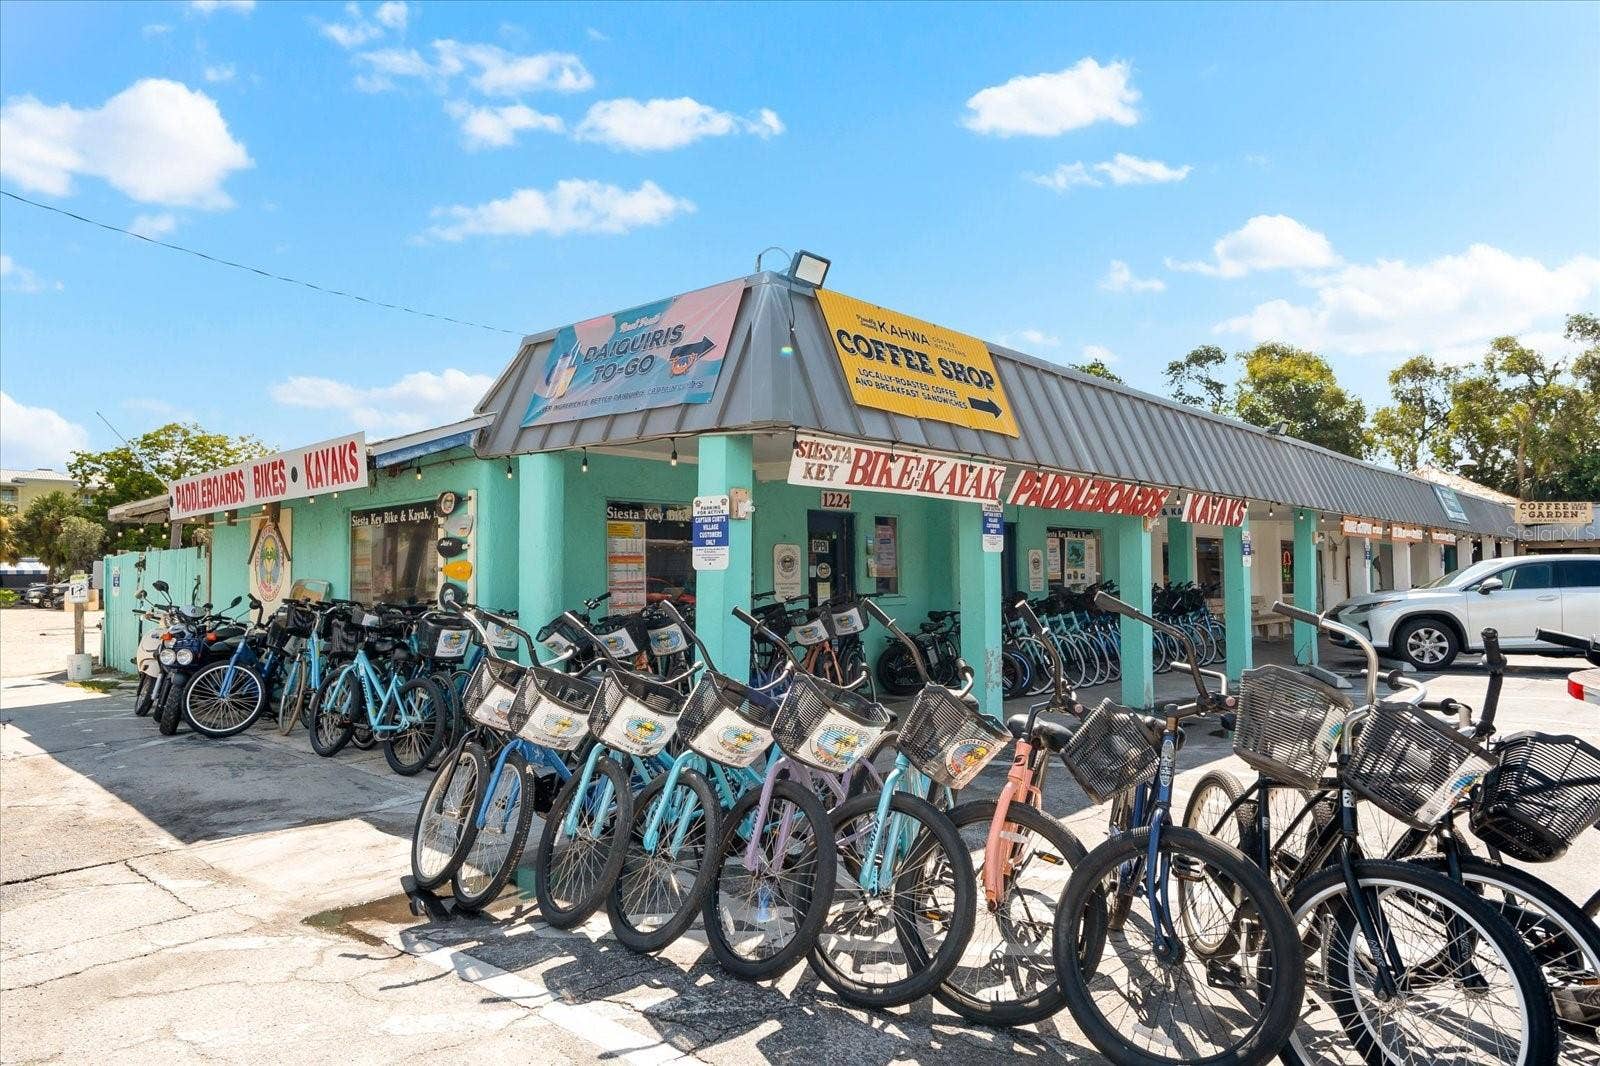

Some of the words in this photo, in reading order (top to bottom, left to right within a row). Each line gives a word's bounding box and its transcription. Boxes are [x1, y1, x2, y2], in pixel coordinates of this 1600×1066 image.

[582, 323, 687, 367] DAIQUIRIS
[877, 320, 931, 346] KAHWA
[590, 354, 656, 385] TO-GO
[836, 328, 936, 377] COFFEE
[937, 356, 996, 392] SHOP
[855, 376, 874, 387] AND
[875, 382, 920, 398] BREAKFAST
[921, 392, 968, 409] SANDWICHES
[858, 367, 930, 391] LOCALLY-ROASTED
[931, 385, 958, 399] COFFEE
[795, 439, 852, 465] SIESTA
[175, 468, 246, 514] PADDLEBOARDS
[253, 458, 287, 499] BIKES
[304, 440, 359, 490] KAYAKS
[802, 462, 840, 482] KEY
[845, 447, 922, 490] BIKE
[916, 458, 1006, 501] KAYAK
[823, 492, 851, 509] 1224
[1010, 470, 1171, 518] PADDLEBOARDS
[1187, 493, 1249, 528] KAYAKS
[1520, 502, 1569, 510] COFFEE
[352, 515, 369, 527] Siesta
[370, 513, 383, 527] Key
[384, 511, 398, 524] Bike
[400, 510, 407, 522] &
[606, 505, 640, 520] Siesta
[644, 508, 665, 523] Key
[1528, 510, 1579, 518] GARDEN
